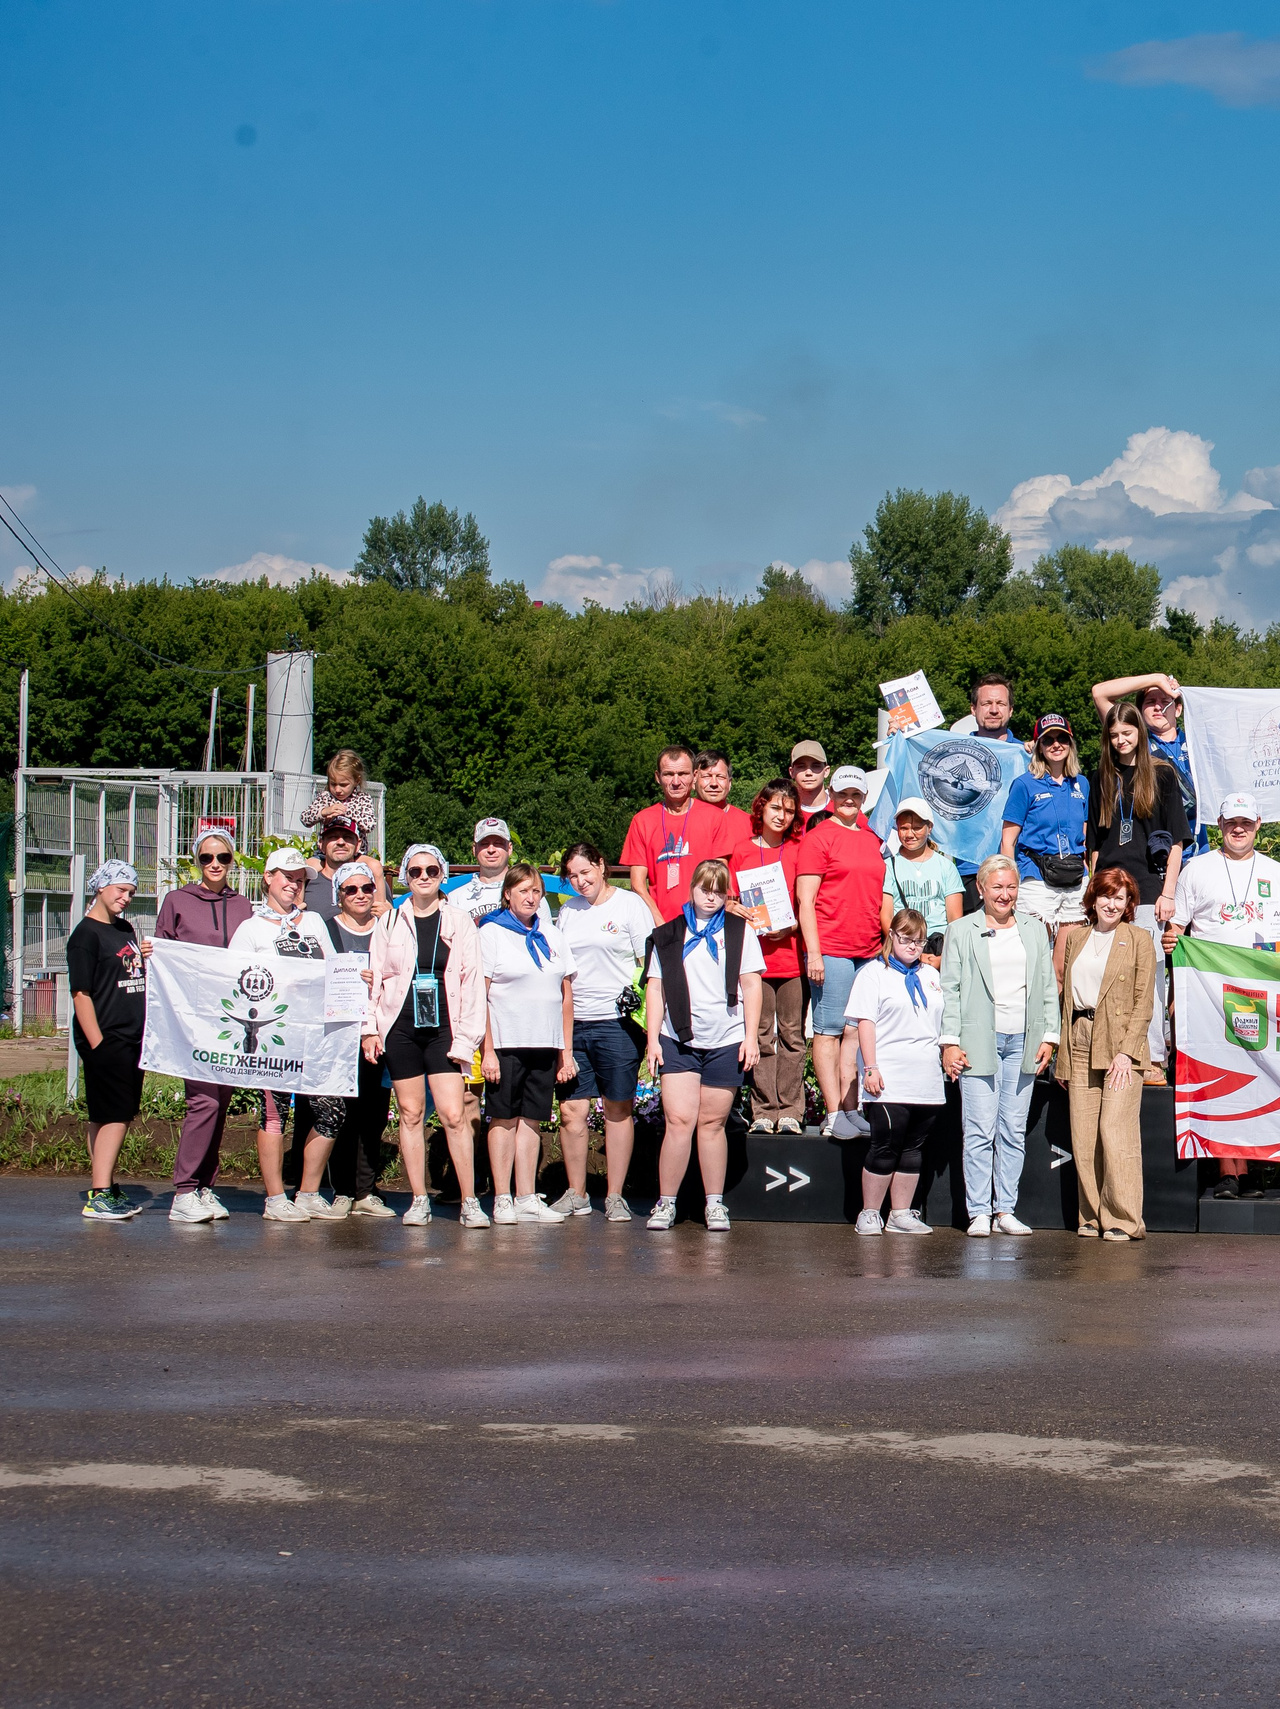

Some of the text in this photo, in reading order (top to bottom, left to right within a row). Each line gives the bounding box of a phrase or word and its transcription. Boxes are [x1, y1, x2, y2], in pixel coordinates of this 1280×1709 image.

[192, 1049, 304, 1073] СОВЕТЖЕНЩИН
[211, 1065, 284, 1078] ГОРОД ДЗЕРЖИНСК
